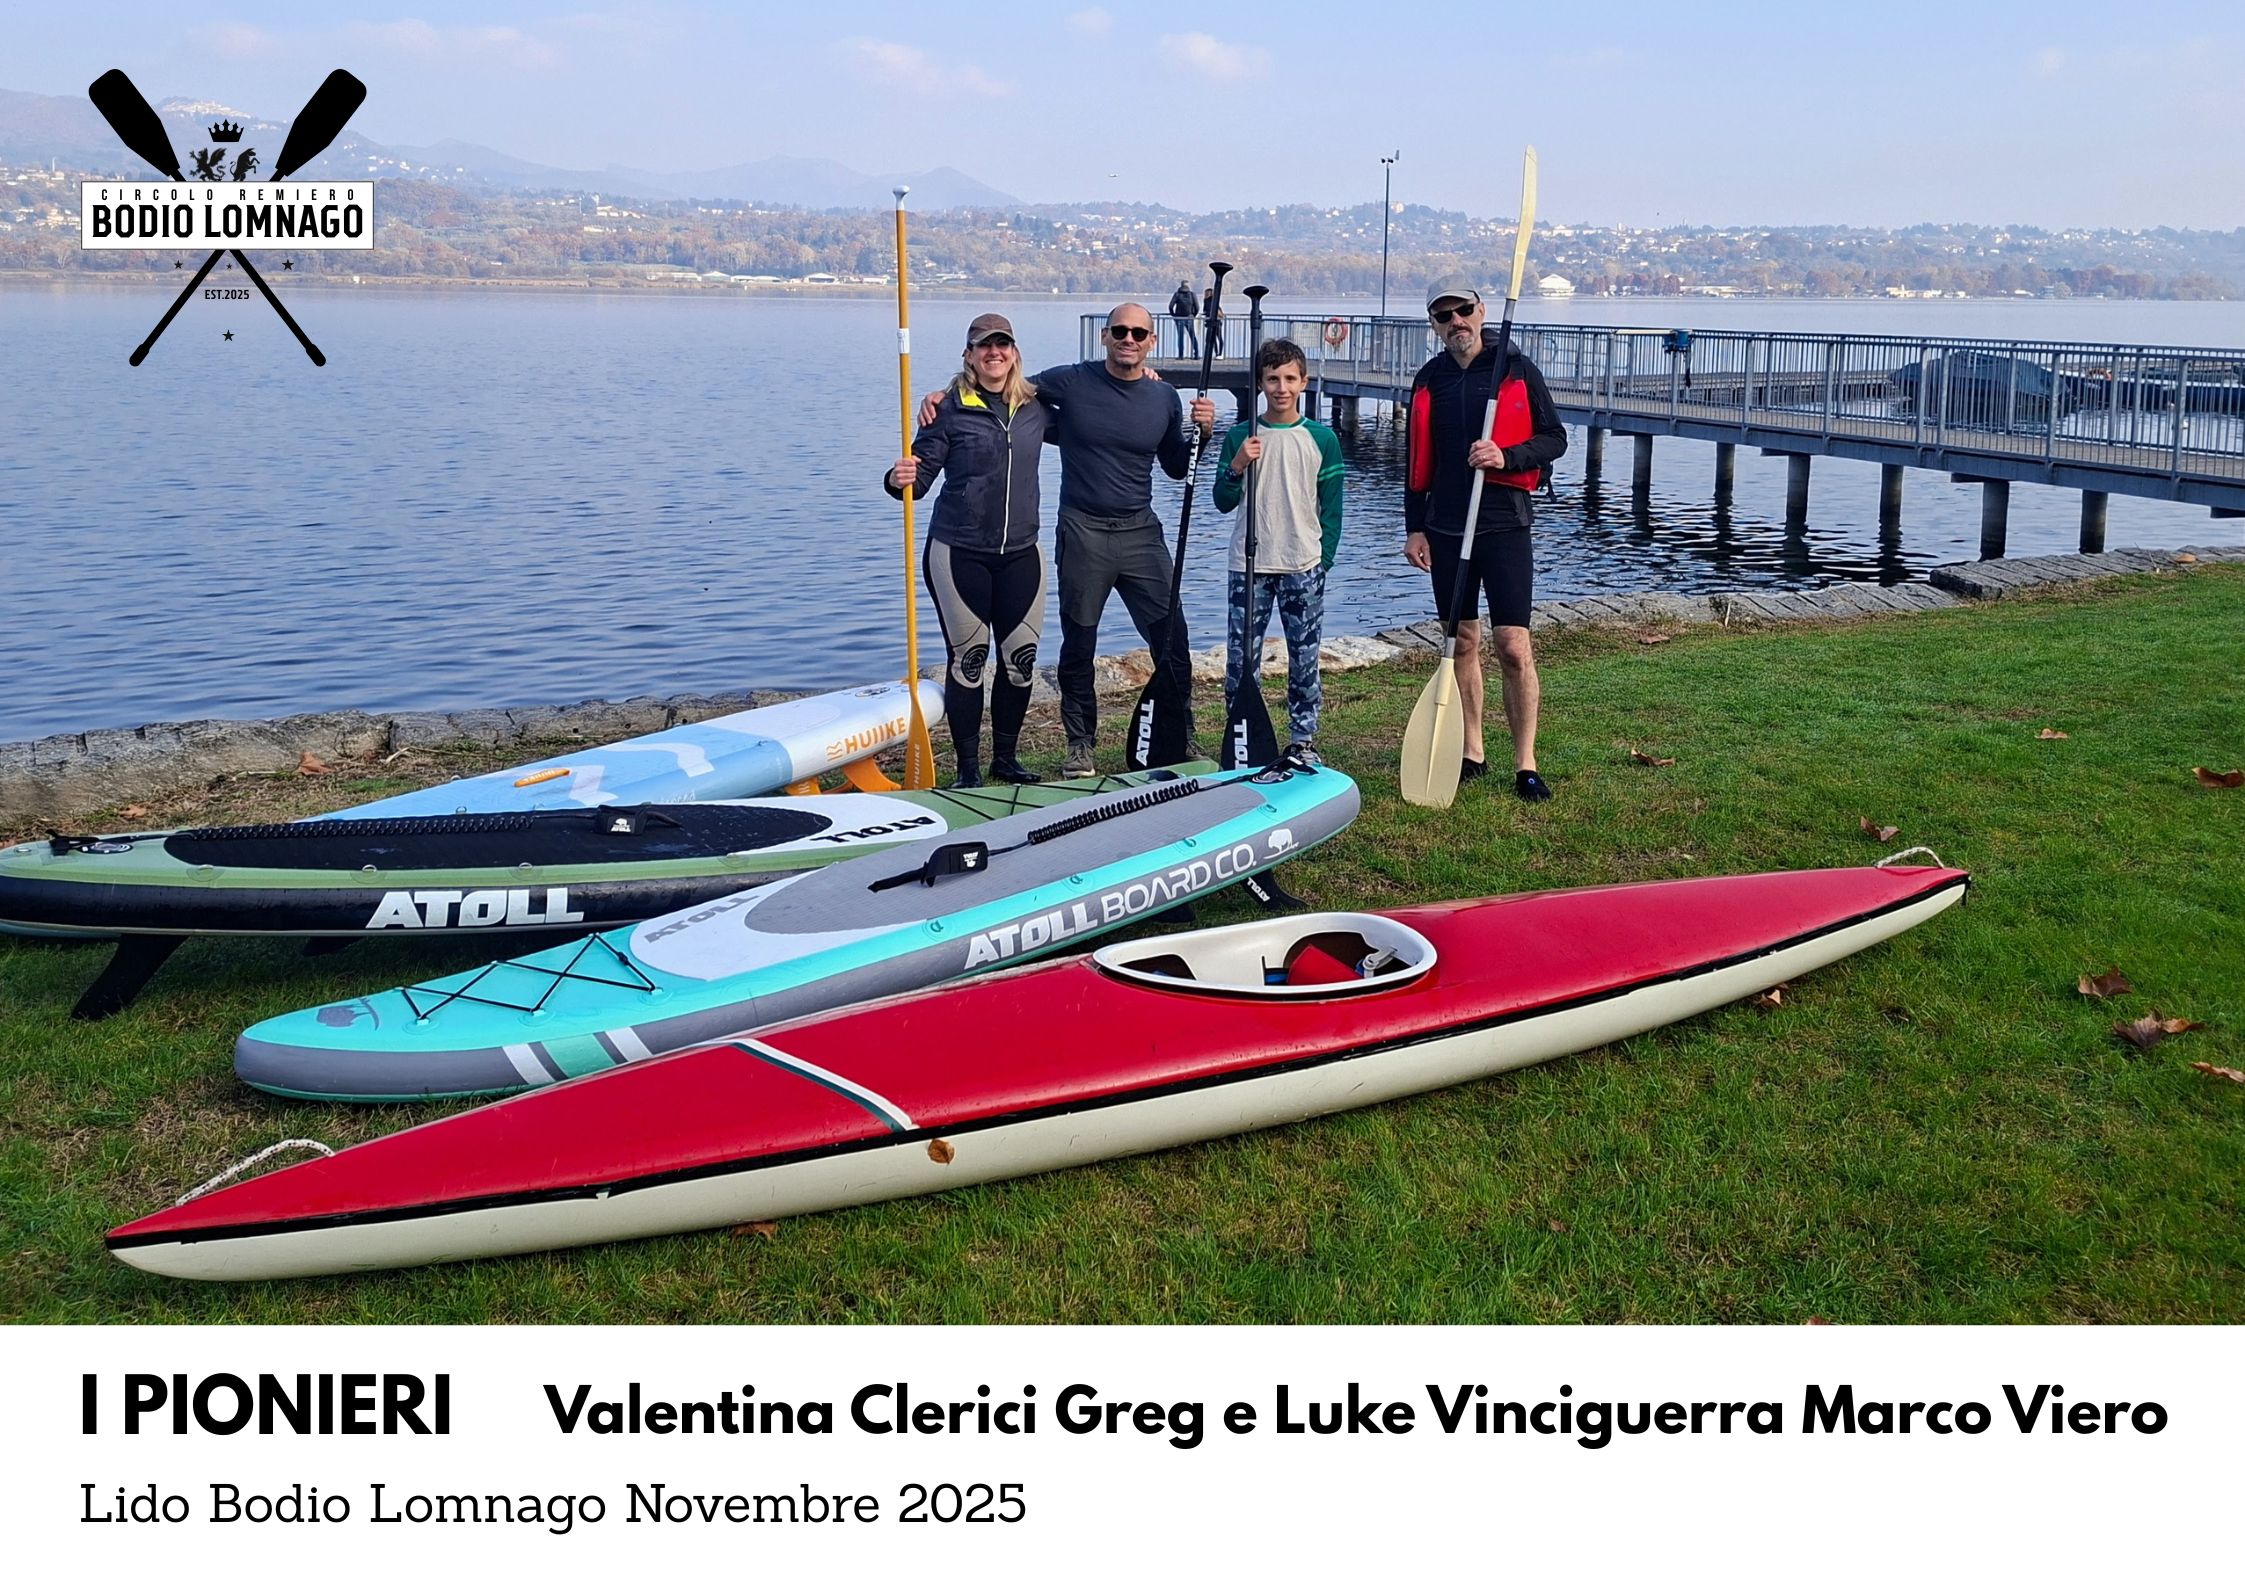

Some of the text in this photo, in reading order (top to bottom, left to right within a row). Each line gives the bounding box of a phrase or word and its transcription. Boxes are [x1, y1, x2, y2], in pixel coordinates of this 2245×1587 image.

[843, 716, 906, 755] HUIIKE
[1136, 699, 1154, 767] ATOLL
[1233, 719, 1248, 770] TOLL
[365, 887, 584, 928] ATOLL
[644, 896, 758, 943] ATOLL
[964, 843, 1257, 970] ATOLL BOARD CO.
